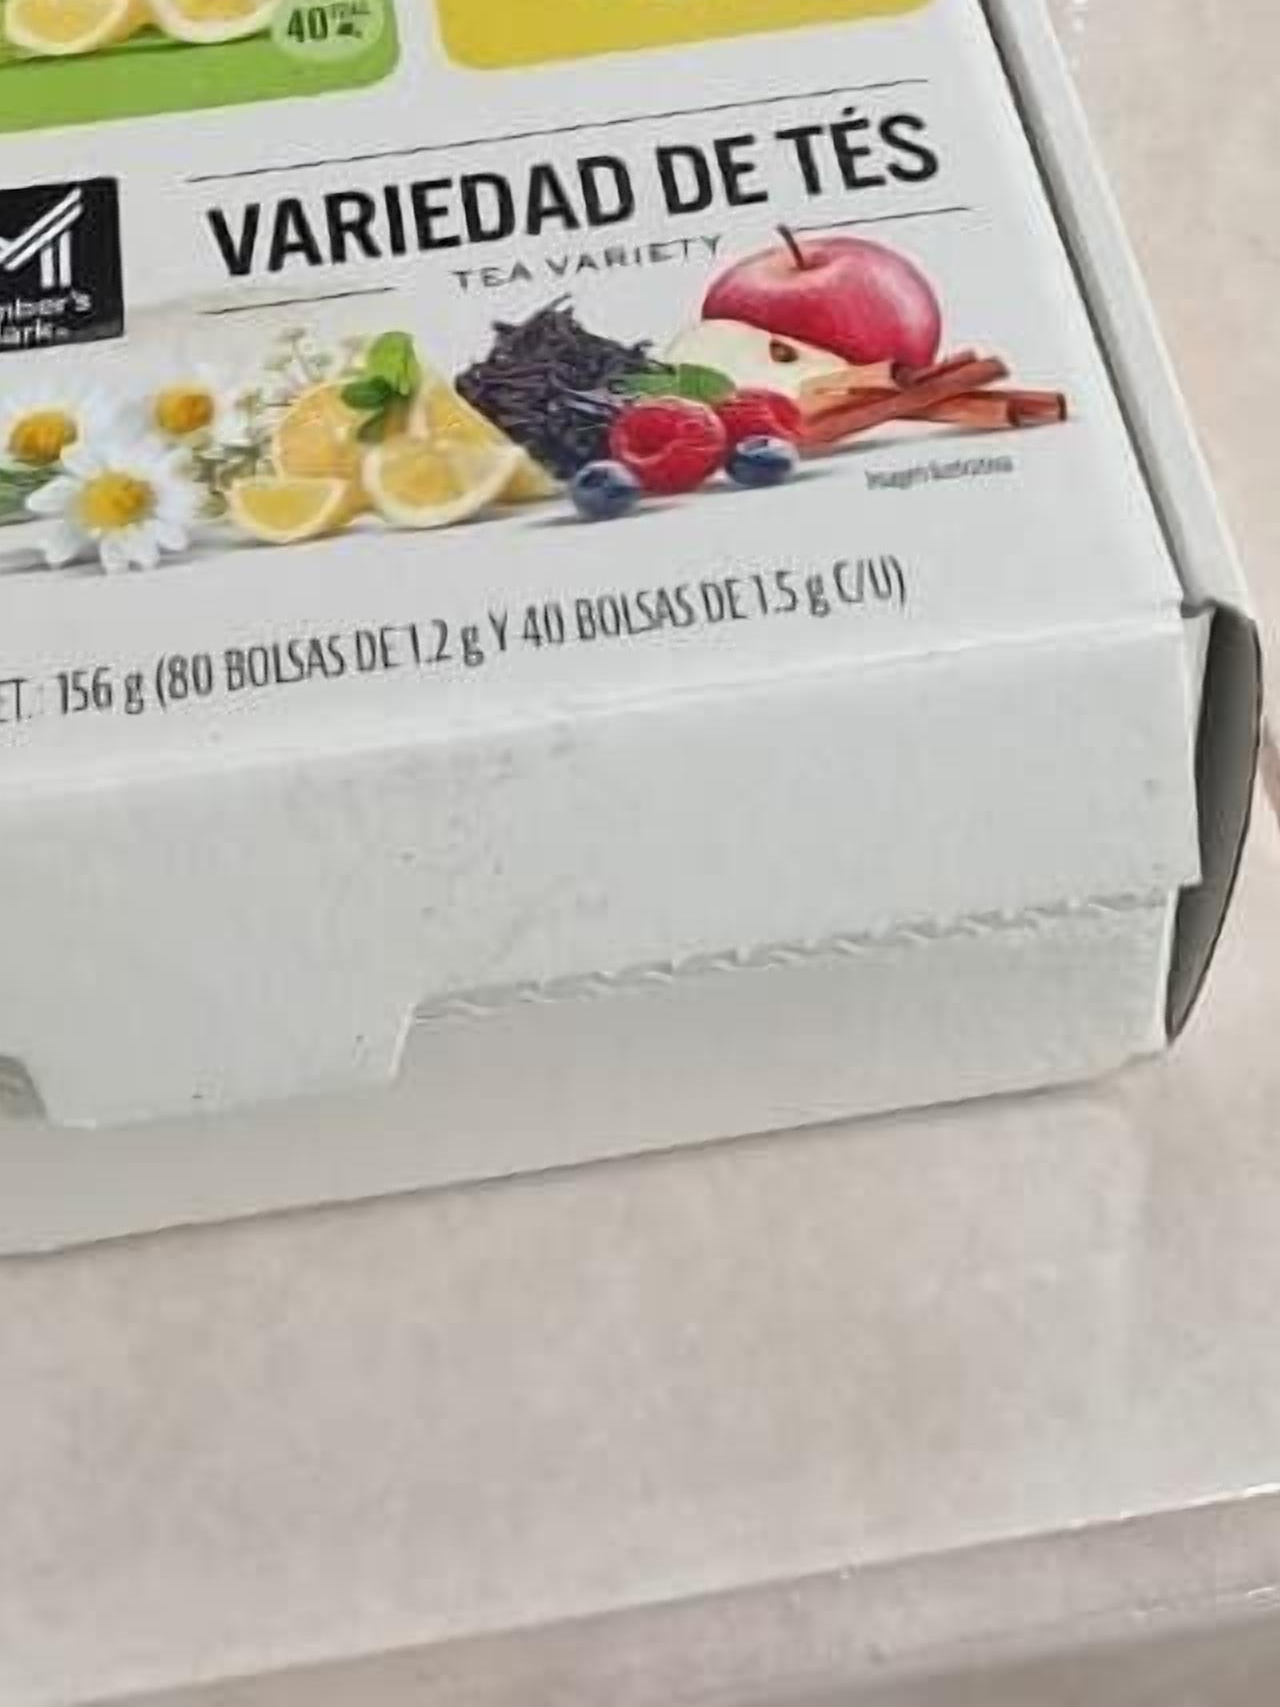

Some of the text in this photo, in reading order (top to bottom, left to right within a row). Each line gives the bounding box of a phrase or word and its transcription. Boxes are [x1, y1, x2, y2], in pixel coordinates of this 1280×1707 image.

[287, 6, 328, 43] 40
[206, 105, 940, 277] VARIEDAD DE TÉS
[452, 233, 723, 291] TEA VARIETY
[56, 666, 112, 716] 156
[124, 671, 144, 715] g
[155, 652, 214, 710] (80
[224, 635, 346, 693] BOLSAS
[354, 625, 405, 673] DE
[460, 624, 485, 668] g
[486, 606, 510, 653] Y
[521, 602, 565, 648] 40
[574, 582, 697, 642] BOLSAS
[702, 577, 749, 625] DE
[750, 570, 799, 616] 1.5
[804, 573, 831, 619] g
